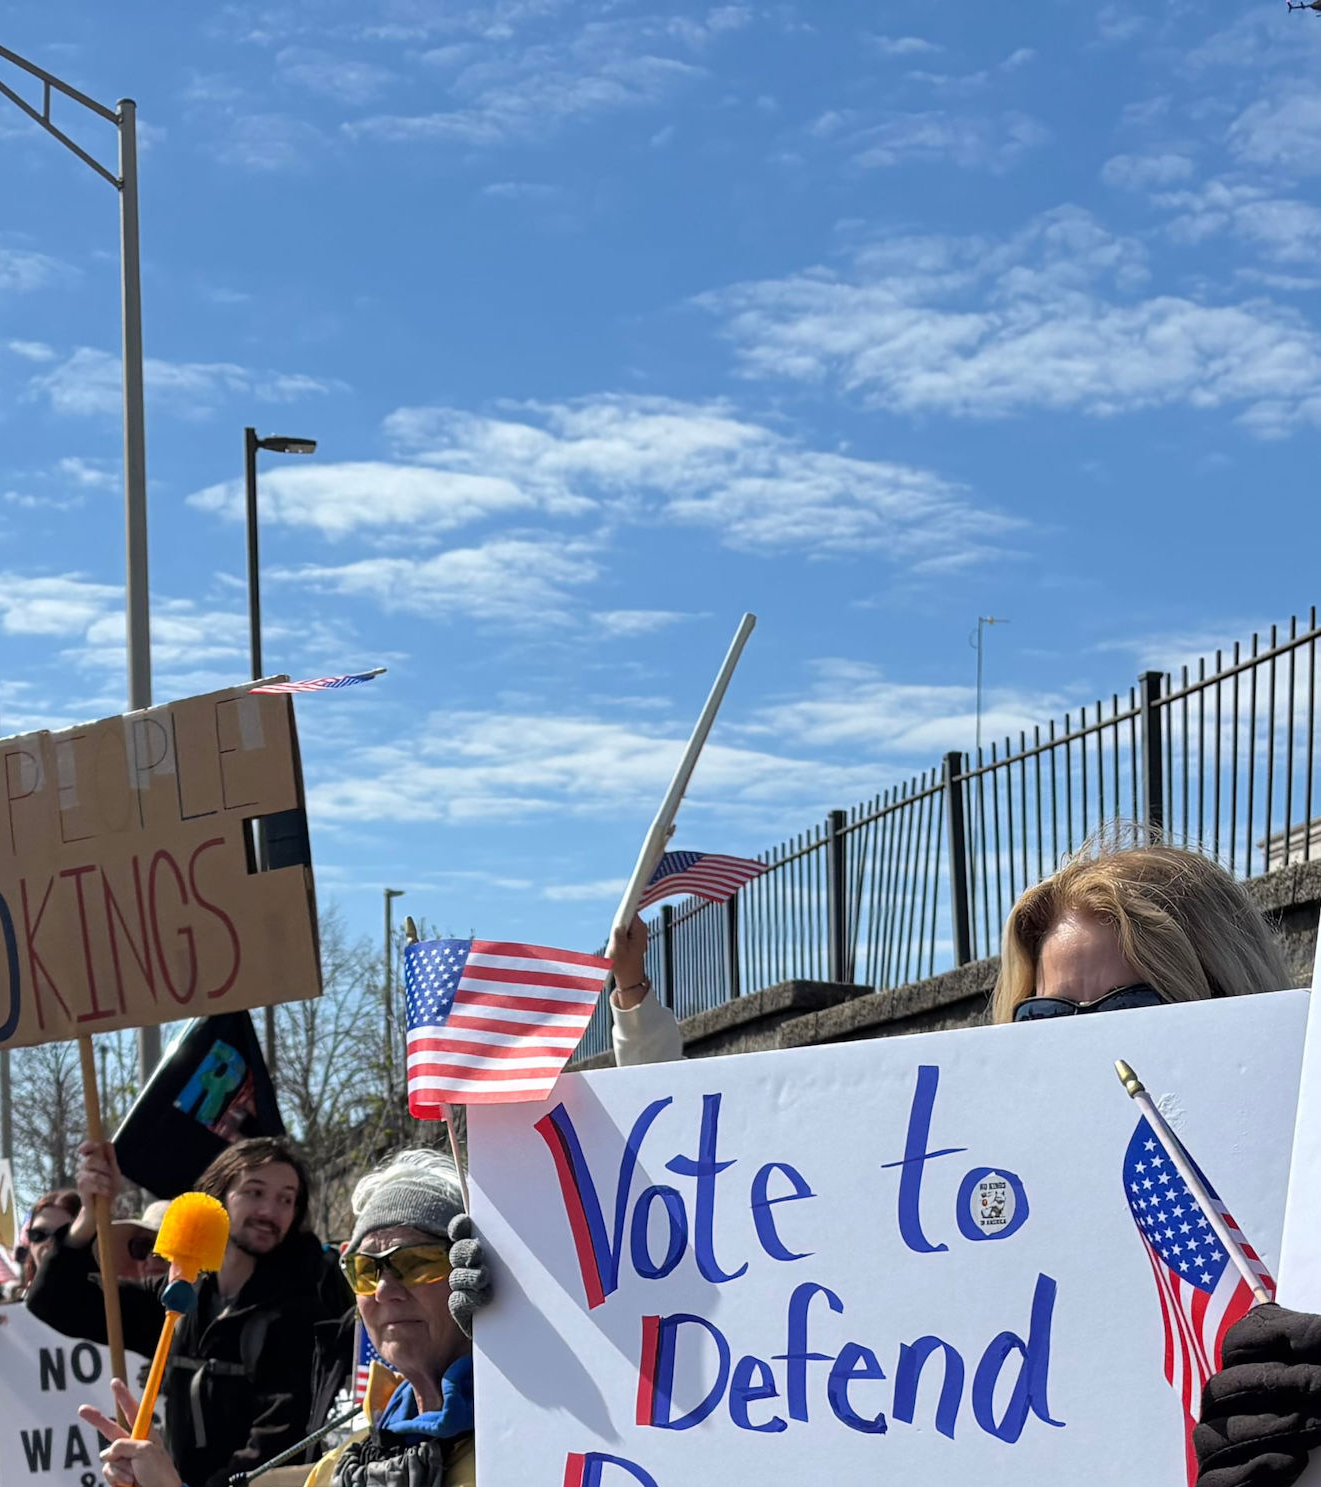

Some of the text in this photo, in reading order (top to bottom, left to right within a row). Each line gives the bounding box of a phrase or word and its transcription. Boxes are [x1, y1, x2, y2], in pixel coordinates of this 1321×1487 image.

[4, 696, 259, 856] PEOPLE
[20, 837, 242, 1031] KINGS
[533, 1065, 1029, 1308] Vote to
[38, 1341, 103, 1392] NO
[635, 1272, 1066, 1443] Defend
[19, 1415, 124, 1474] WA
